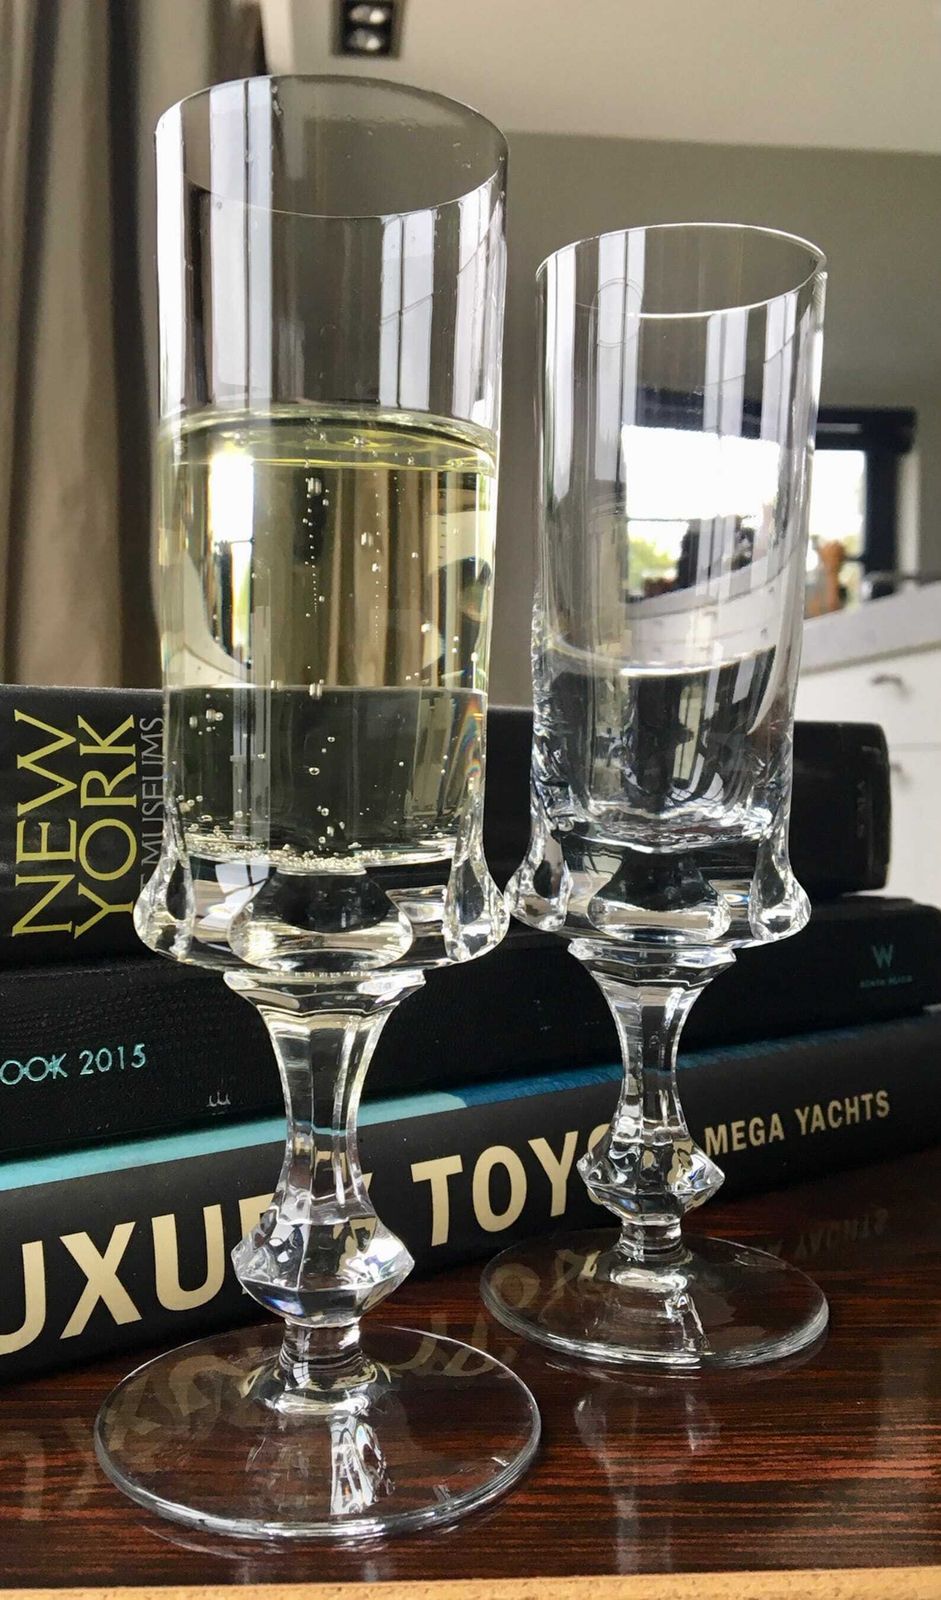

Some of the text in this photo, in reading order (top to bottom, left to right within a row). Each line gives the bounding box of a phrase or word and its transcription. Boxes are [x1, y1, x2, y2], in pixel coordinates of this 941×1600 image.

[12, 709, 77, 937] NEW
[74, 714, 137, 939] YORK
[139, 717, 164, 866] MUSEUMS
[871, 944, 894, 969] W
[80, 1043, 145, 1075] 2015
[704, 1113, 785, 1157] MEGA
[794, 1090, 890, 1136] YACHTS
